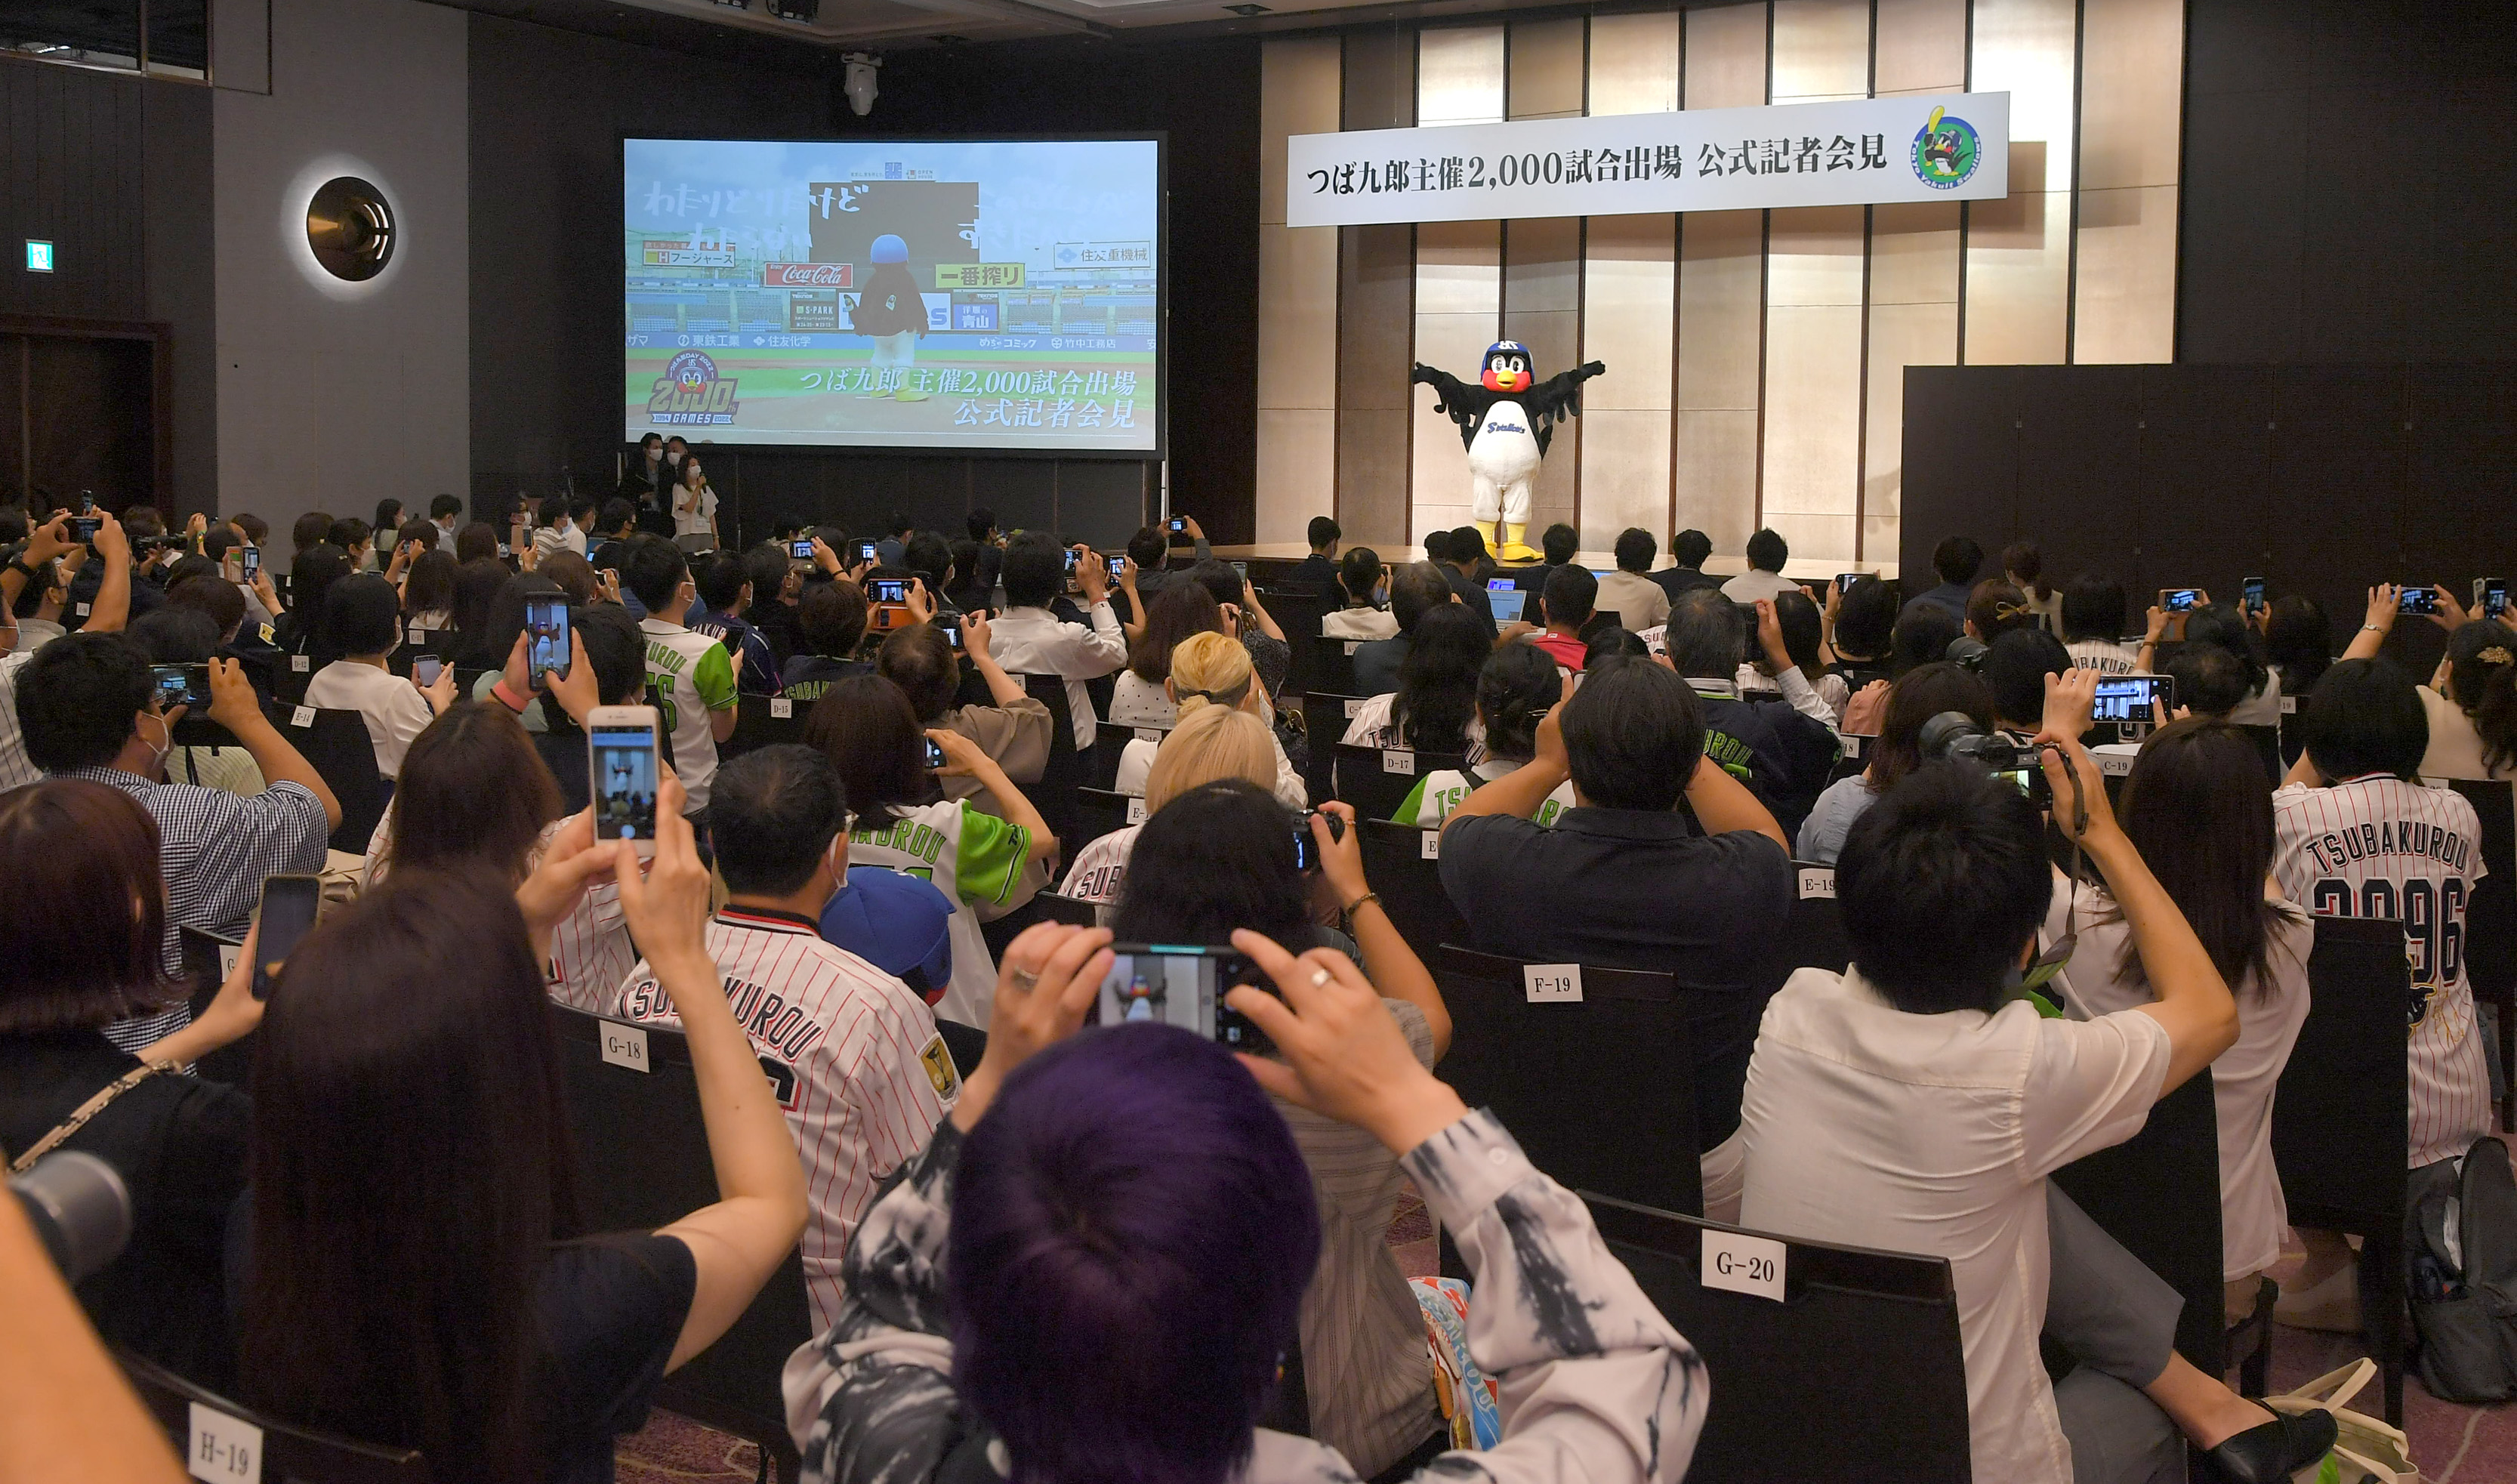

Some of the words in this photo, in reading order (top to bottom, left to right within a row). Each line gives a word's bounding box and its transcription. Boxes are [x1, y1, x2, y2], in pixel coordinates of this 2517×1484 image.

[1306, 143, 1682, 196] つば九郎主催2,000試合出場
[1698, 133, 1888, 177] 公式記者会見
[1911, 140, 1921, 174] Tokyo
[1920, 174, 1954, 189] Yakult
[1957, 137, 1981, 186] Swallows
[671, 253, 733, 264] フージャース
[941, 267, 1019, 286] 一番搾り
[962, 315, 989, 328] 青山
[692, 334, 740, 347] 東鉄工業
[768, 335, 811, 347] 住友化学
[1065, 338, 1117, 350] 竹中工務店
[673, 413, 711, 424] GAMES
[953, 398, 1137, 429] 公式記者会見
[646, 640, 688, 674] UROU
[773, 705, 789, 714] D-15
[295, 712, 310, 723] E-14
[1387, 757, 1409, 769] D-17
[2104, 761, 2128, 771] C-19
[2305, 819, 2469, 875] TSUBAKUROU
[1804, 878, 1835, 892] E-19
[1534, 976, 1571, 993] F-19
[609, 1036, 641, 1060] G-18
[1716, 1251, 1775, 1282] G-20
[200, 1432, 248, 1476] H-19
